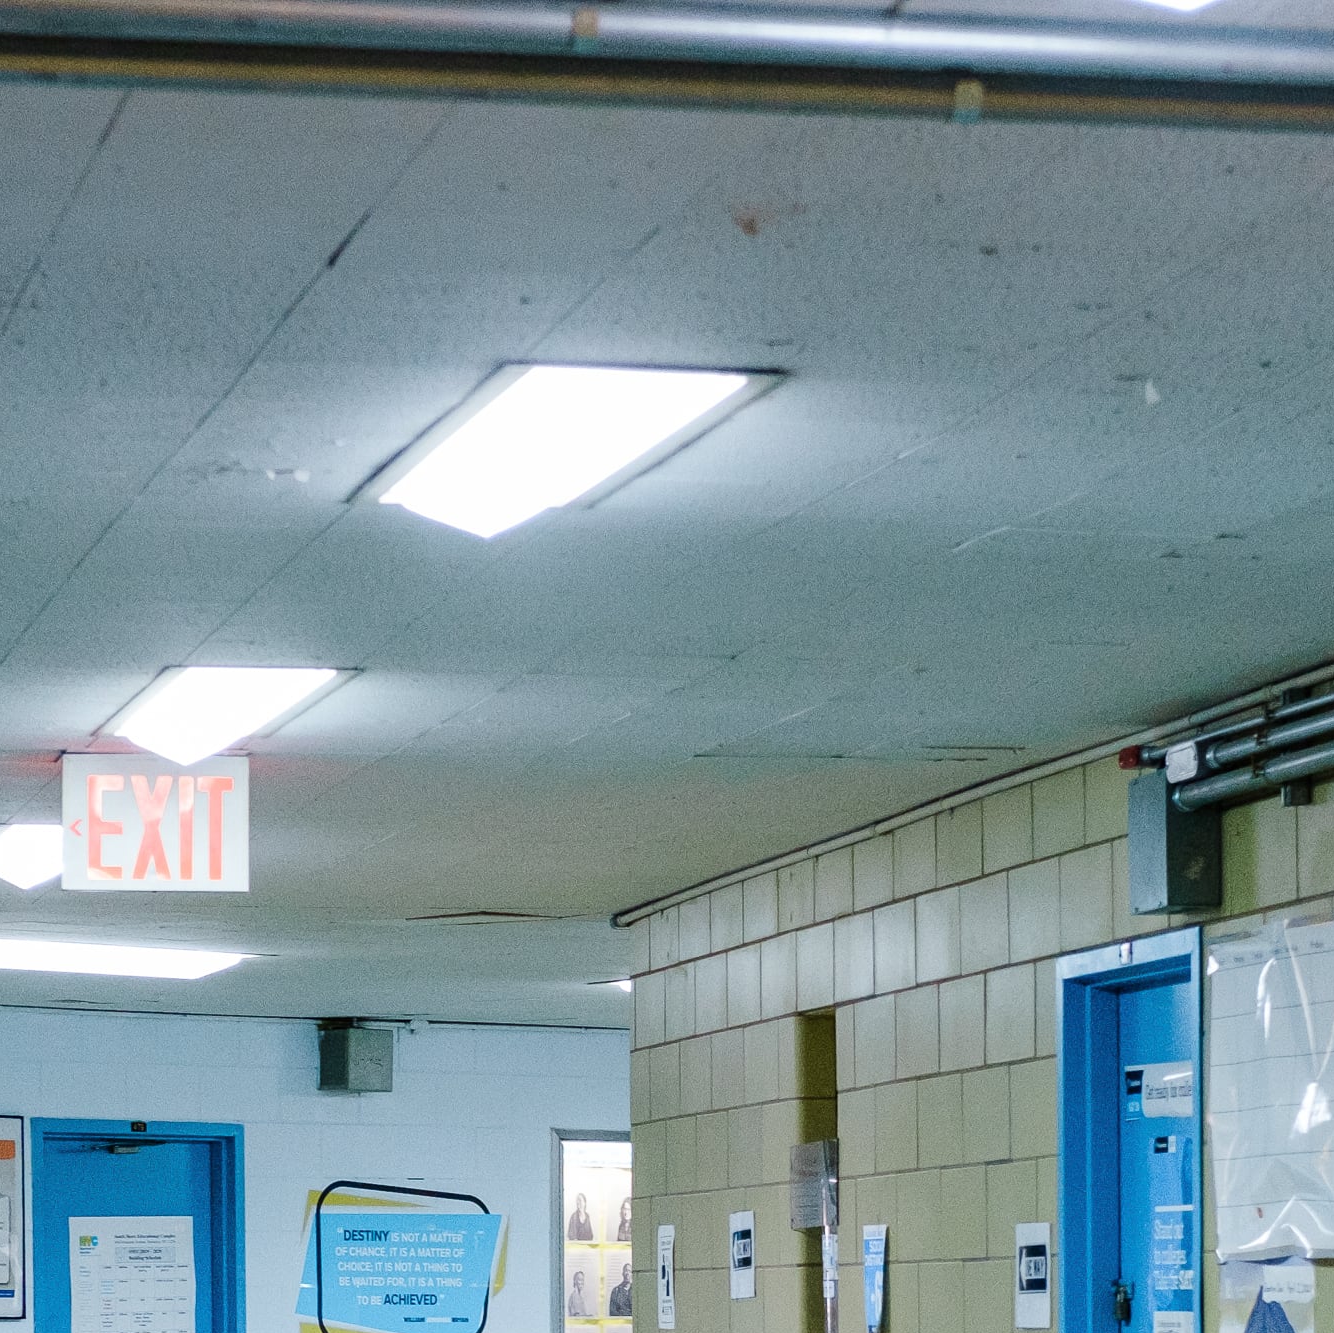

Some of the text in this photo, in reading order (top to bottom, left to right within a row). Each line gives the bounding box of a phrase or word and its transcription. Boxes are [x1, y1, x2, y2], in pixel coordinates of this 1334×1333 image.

[87, 774, 235, 880] EXIT
[391, 1232, 399, 1242] IS
[402, 1232, 419, 1243] NOT
[421, 1233, 428, 1242] A
[429, 1233, 463, 1243] MATTER
[336, 1247, 348, 1257] OF
[389, 1247, 398, 1257] IT
[399, 1247, 408, 1257] IS
[409, 1247, 416, 1257] A
[418, 1248, 451, 1258] MATTER
[452, 1248, 466, 1258] OF
[375, 1262, 383, 1271] IT
[384, 1262, 393, 1272] IS
[395, 1262, 412, 1272] NOT
[414, 1262, 421, 1272] A
[422, 1262, 449, 1272] THING
[450, 1263, 463, 1273] TO
[339, 1276, 351, 1286] BE
[352, 1276, 385, 1288] WAITED
[408, 1277, 416, 1287] IT
[418, 1277, 427, 1287] IS
[427, 1277, 435, 1287] A
[435, 1277, 463, 1287] THING
[356, 1295, 369, 1305] TO
[370, 1295, 383, 1305] BE
